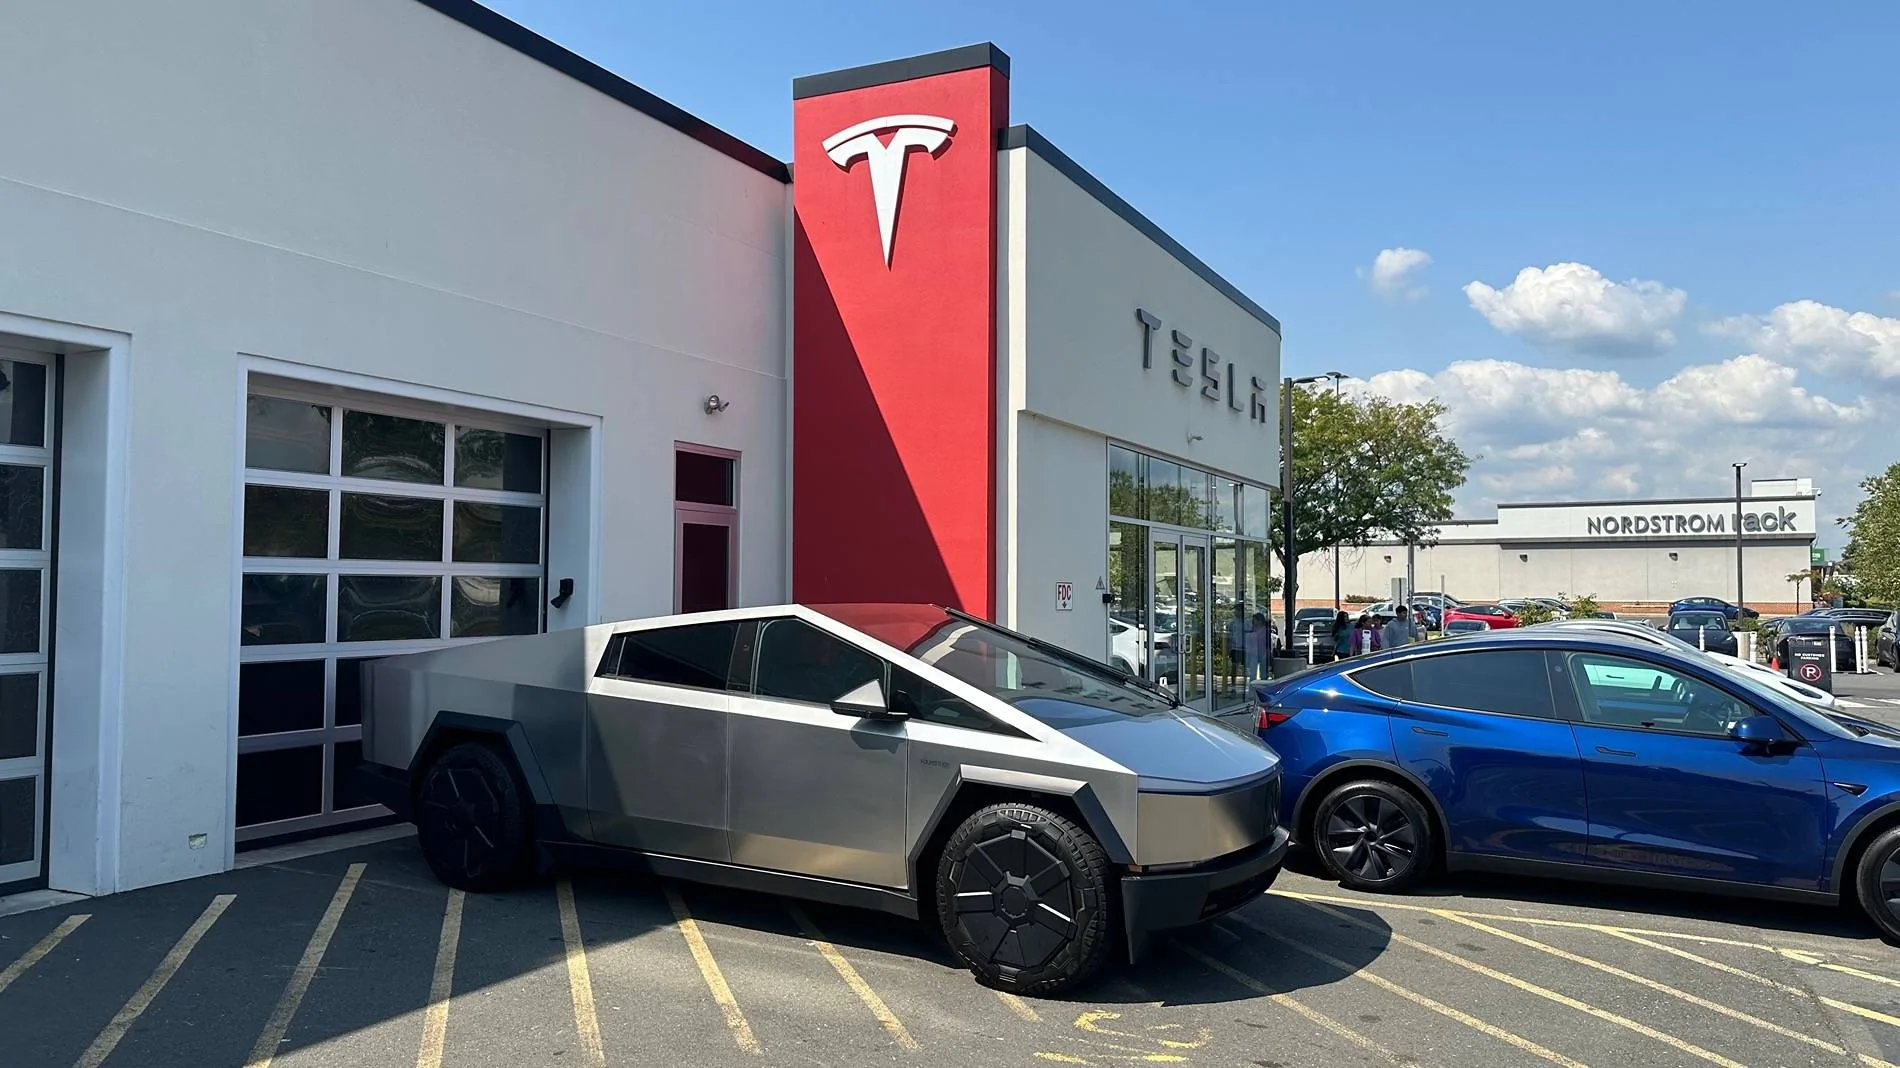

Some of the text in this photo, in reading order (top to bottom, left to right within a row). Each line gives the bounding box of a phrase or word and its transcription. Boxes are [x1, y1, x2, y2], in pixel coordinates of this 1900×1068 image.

[1136, 308, 1267, 423] TESLA
[1587, 513, 1725, 535] NORDSTROM
[1057, 584, 1072, 601] FDC
